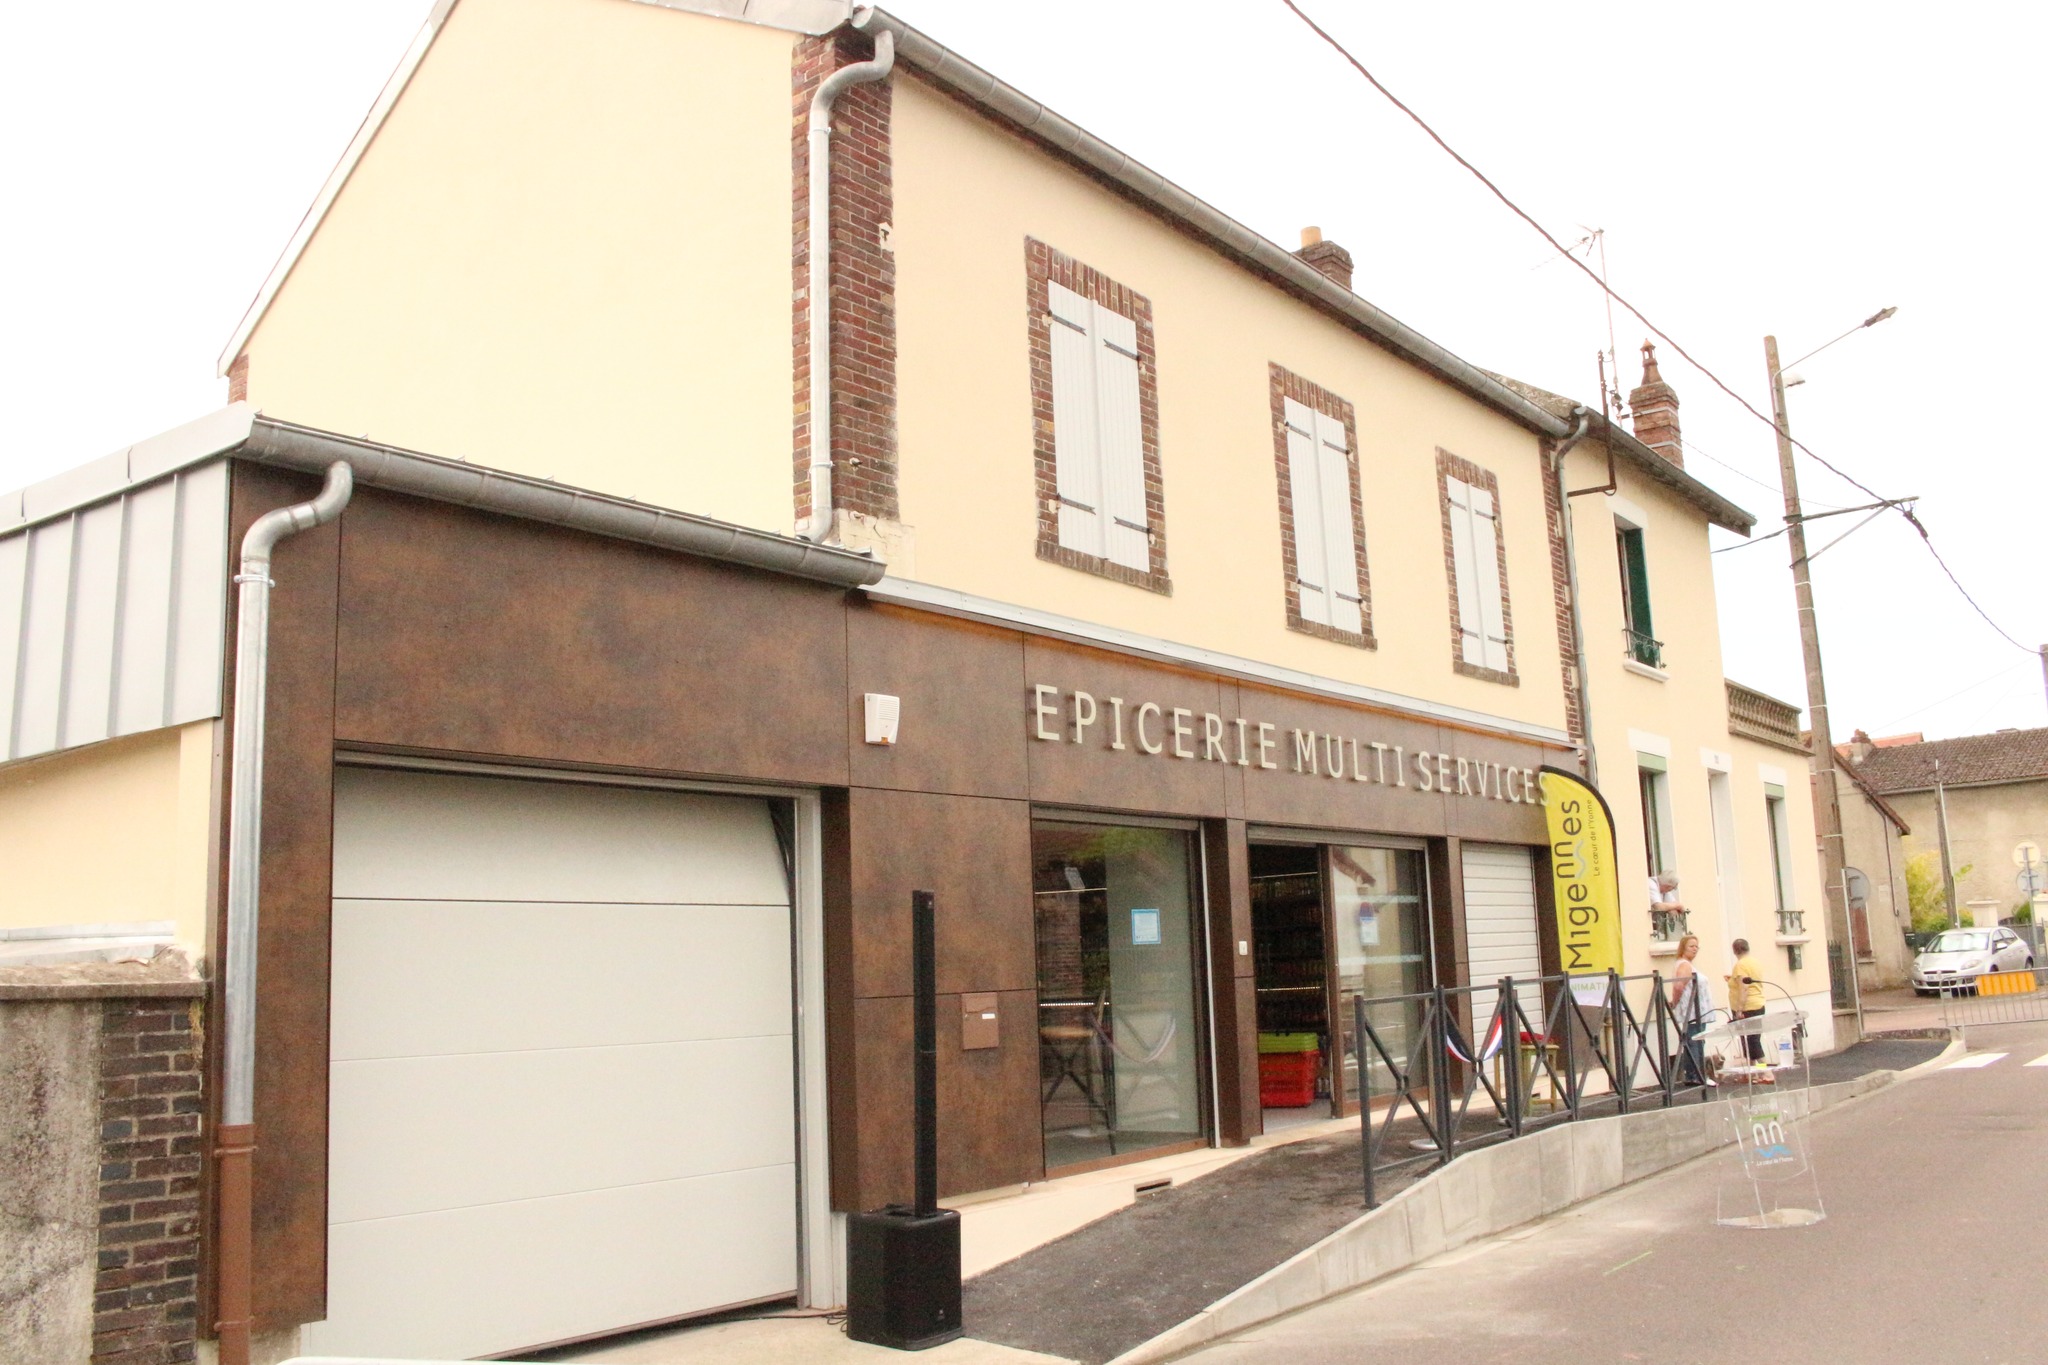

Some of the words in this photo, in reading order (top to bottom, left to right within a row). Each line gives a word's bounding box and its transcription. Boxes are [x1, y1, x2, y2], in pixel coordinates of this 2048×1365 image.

[1035, 683, 1278, 770] EPICERIE
[1294, 727, 1406, 787] MULTI
[1589, 831, 1597, 841] de
[1553, 799, 1599, 969] Migennes
[1593, 866, 1601, 877] Le
